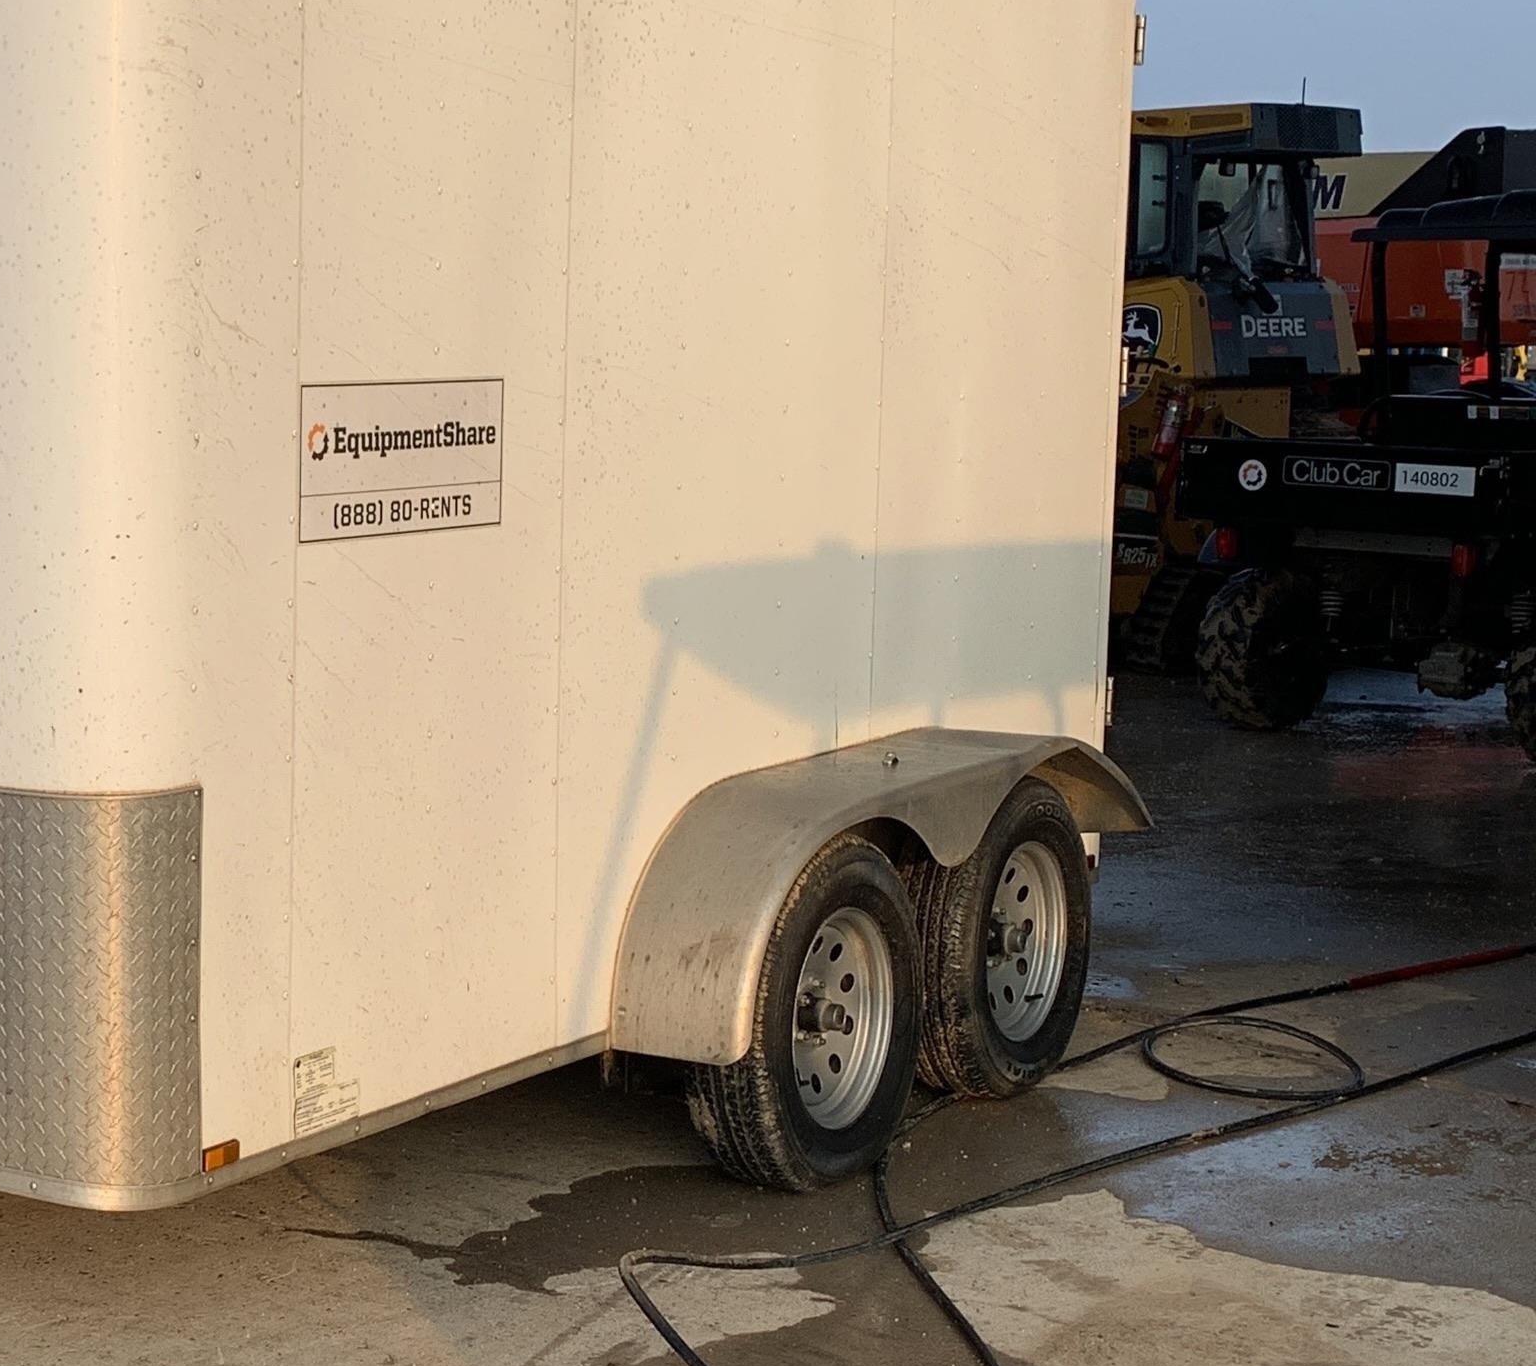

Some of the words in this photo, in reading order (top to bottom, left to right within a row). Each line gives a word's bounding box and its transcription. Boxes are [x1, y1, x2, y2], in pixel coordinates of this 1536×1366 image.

[1240, 314, 1307, 338] DEERE
[332, 421, 496, 459] EquipmentShare
[1292, 459, 1340, 484] Club
[1342, 462, 1381, 487] Car
[1400, 470, 1459, 489] 140802
[333, 499, 383, 529] (888)
[390, 494, 472, 523] 80-RENTS
